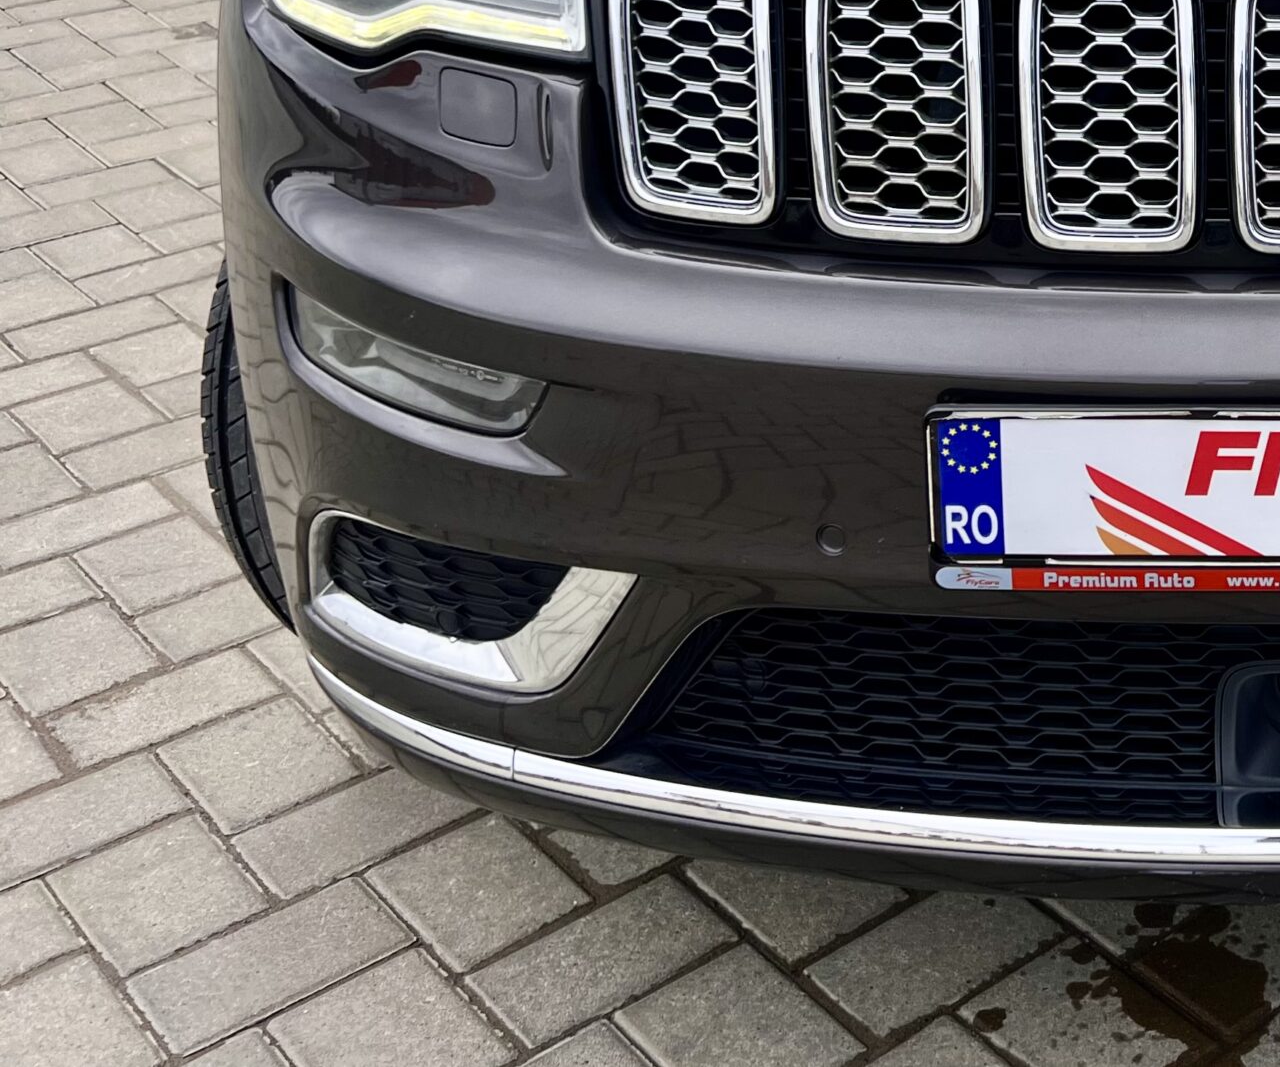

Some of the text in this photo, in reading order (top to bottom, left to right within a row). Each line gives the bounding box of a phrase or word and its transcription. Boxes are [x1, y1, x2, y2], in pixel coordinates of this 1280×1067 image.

[944, 504, 999, 545] RO
[1043, 571, 1138, 588] Premium
[1144, 571, 1195, 588] Auto
